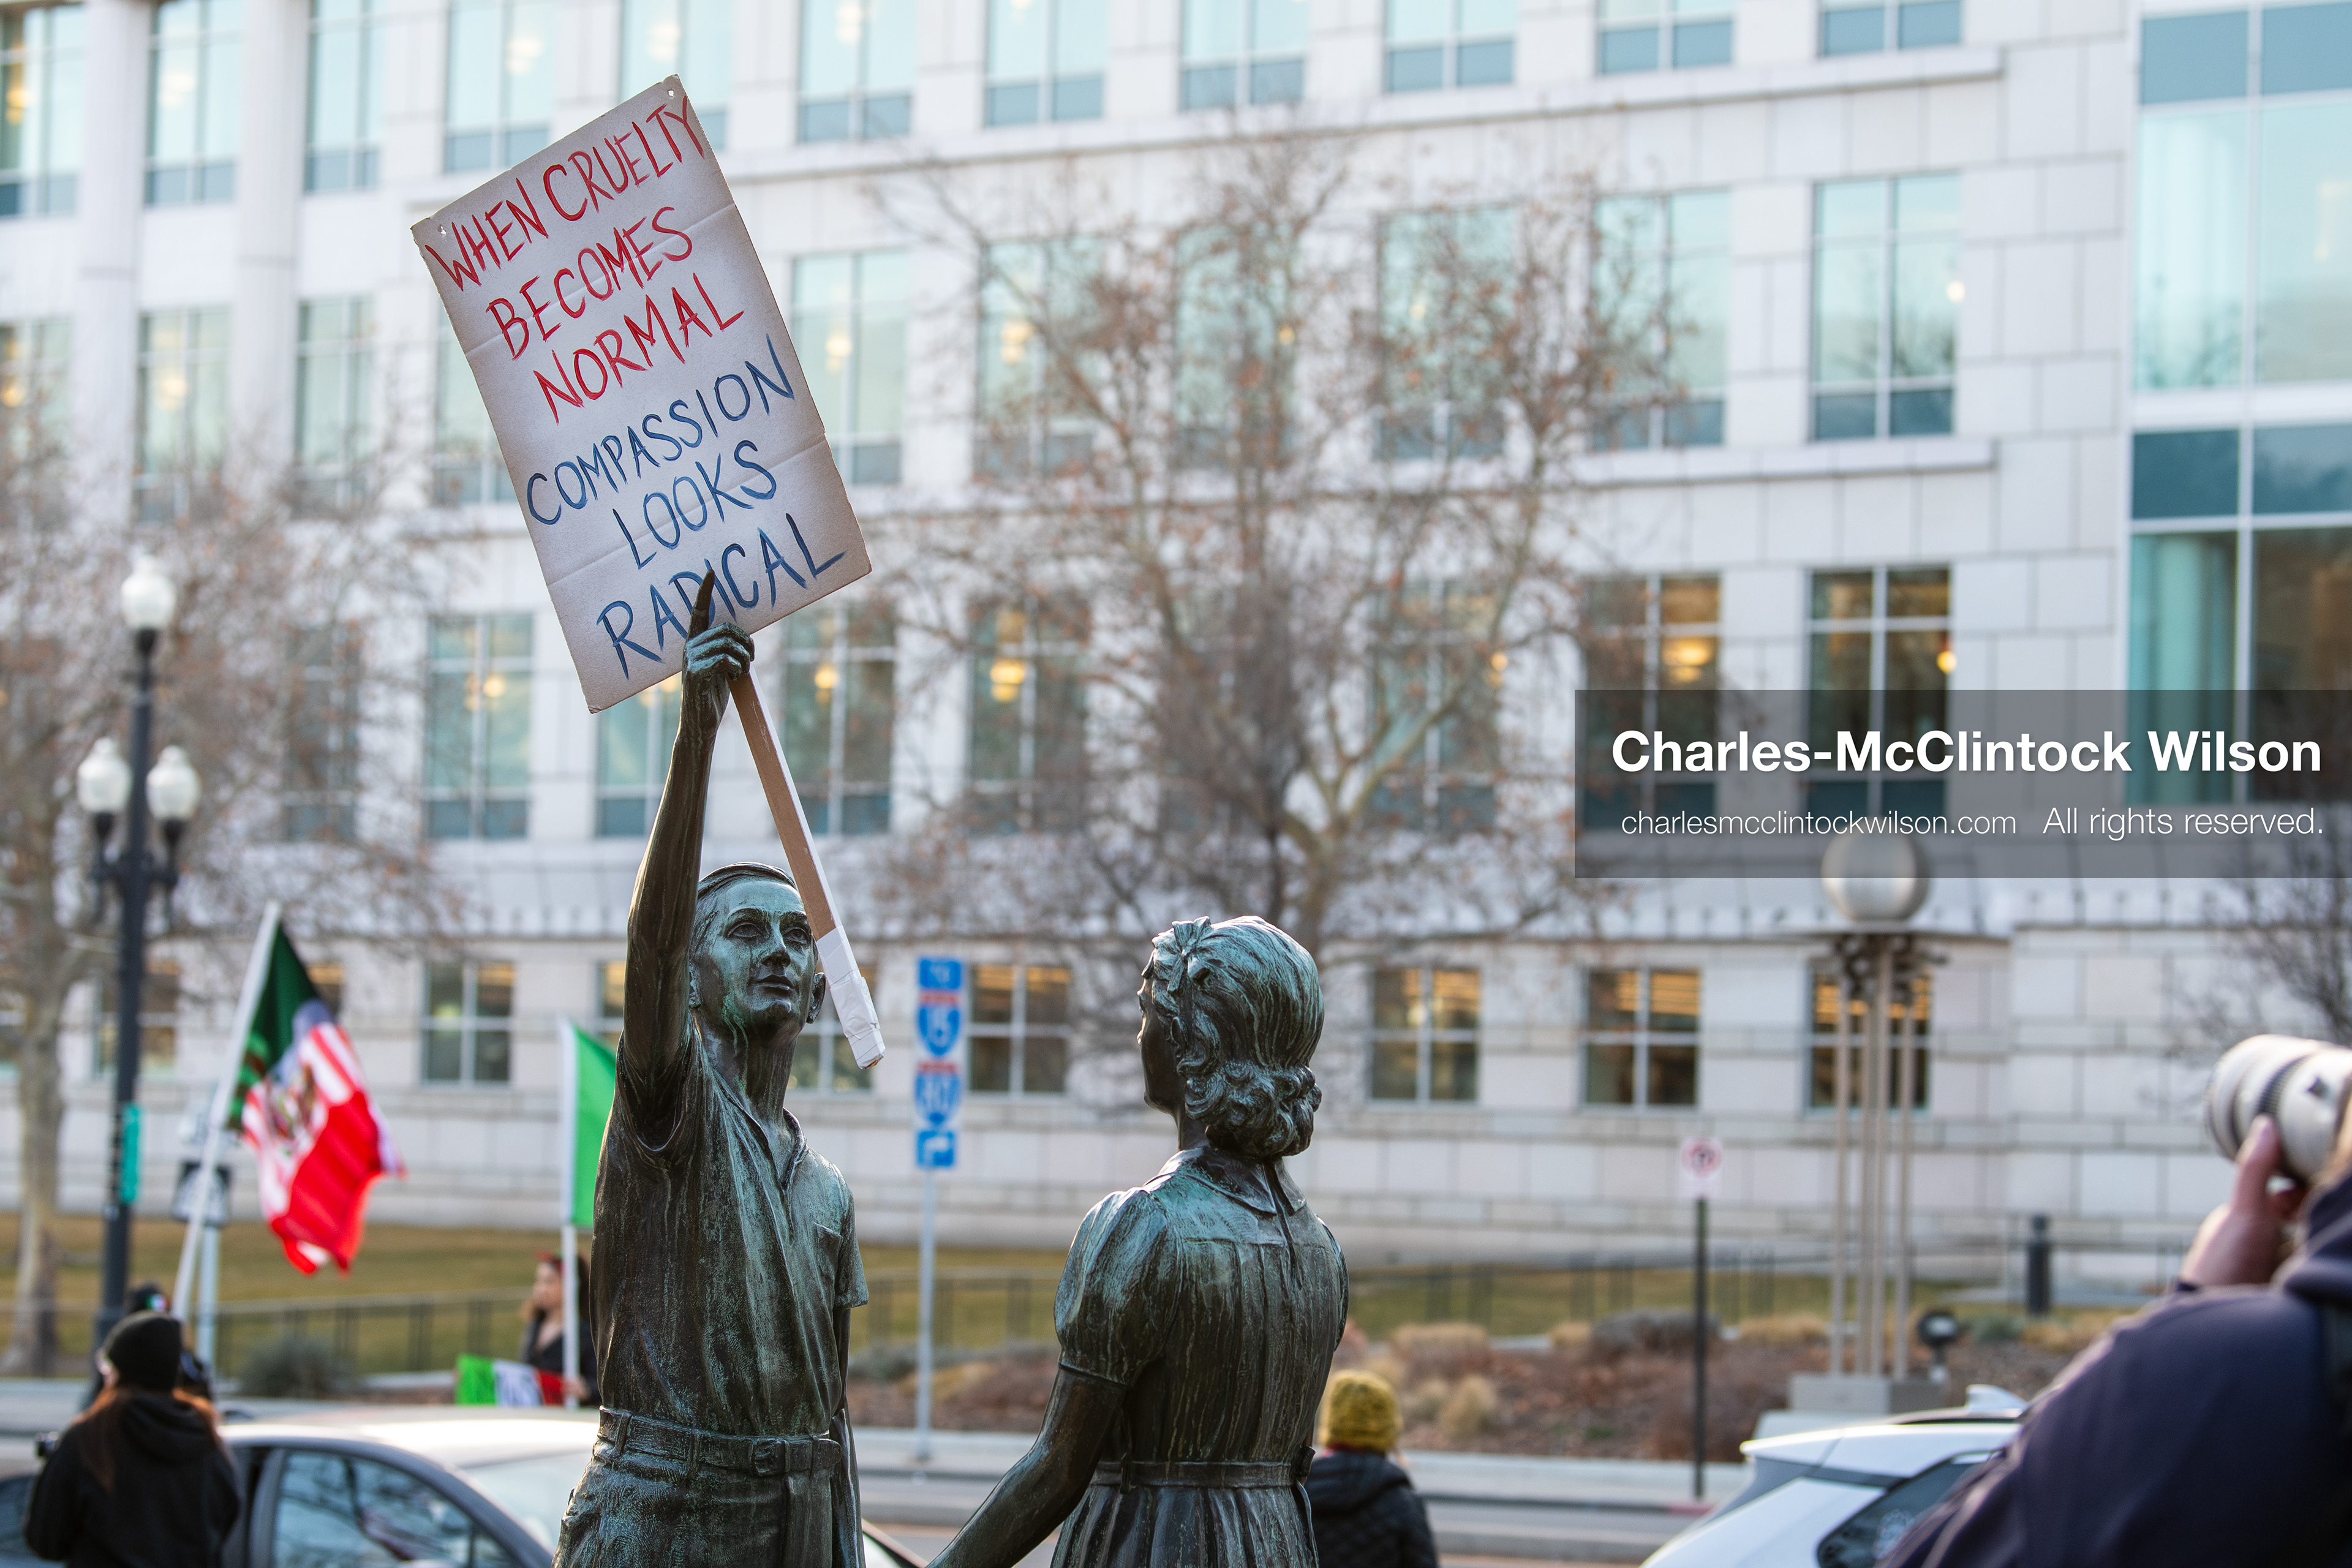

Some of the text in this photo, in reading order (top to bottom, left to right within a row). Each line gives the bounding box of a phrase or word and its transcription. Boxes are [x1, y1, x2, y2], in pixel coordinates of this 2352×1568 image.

[425, 95, 704, 292] WHEN CRUELTY
[486, 206, 693, 360] BECOMES
[533, 273, 744, 425] NORMAL
[527, 333, 794, 525] COMPASSION
[612, 440, 777, 570] LOOKS
[596, 513, 848, 680] RADICAL
